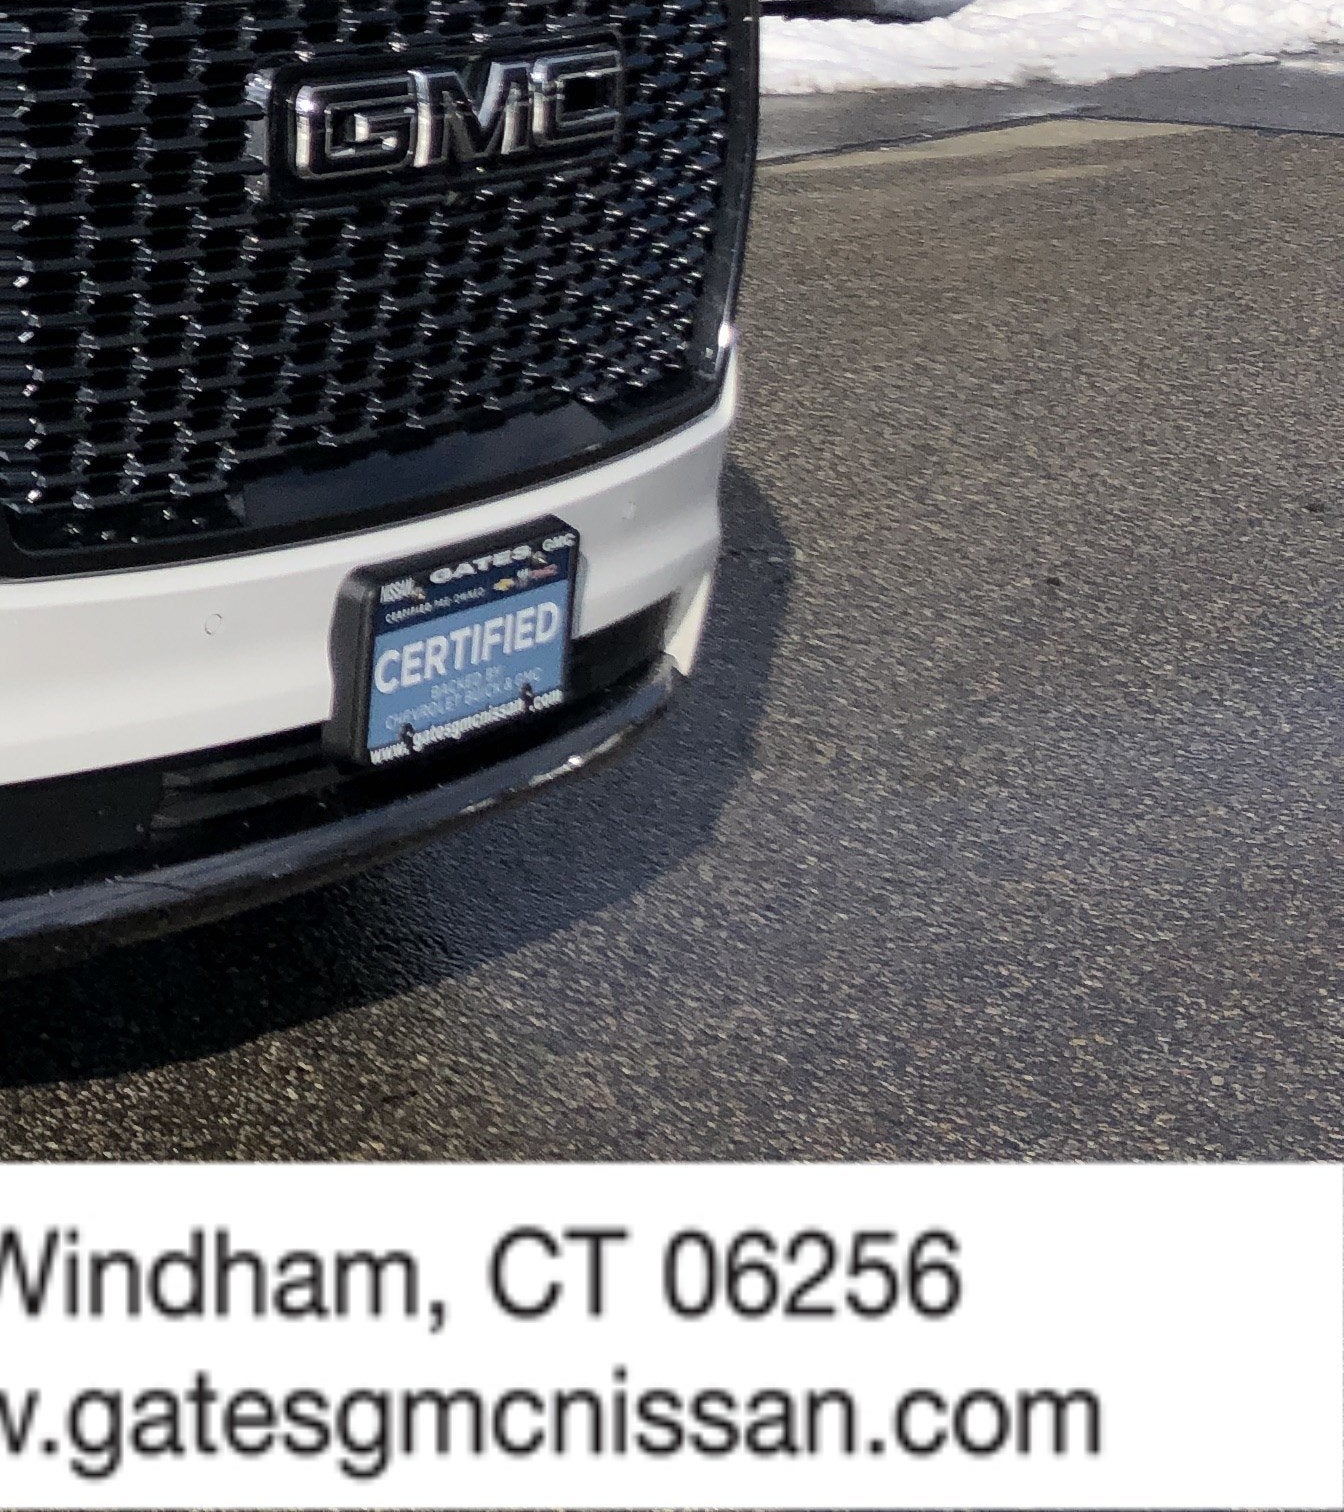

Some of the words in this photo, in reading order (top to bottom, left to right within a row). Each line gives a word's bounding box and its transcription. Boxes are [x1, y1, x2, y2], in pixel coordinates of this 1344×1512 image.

[293, 48, 623, 180] GMC
[429, 545, 533, 585] GATES
[374, 601, 563, 695] CERTIFIED
